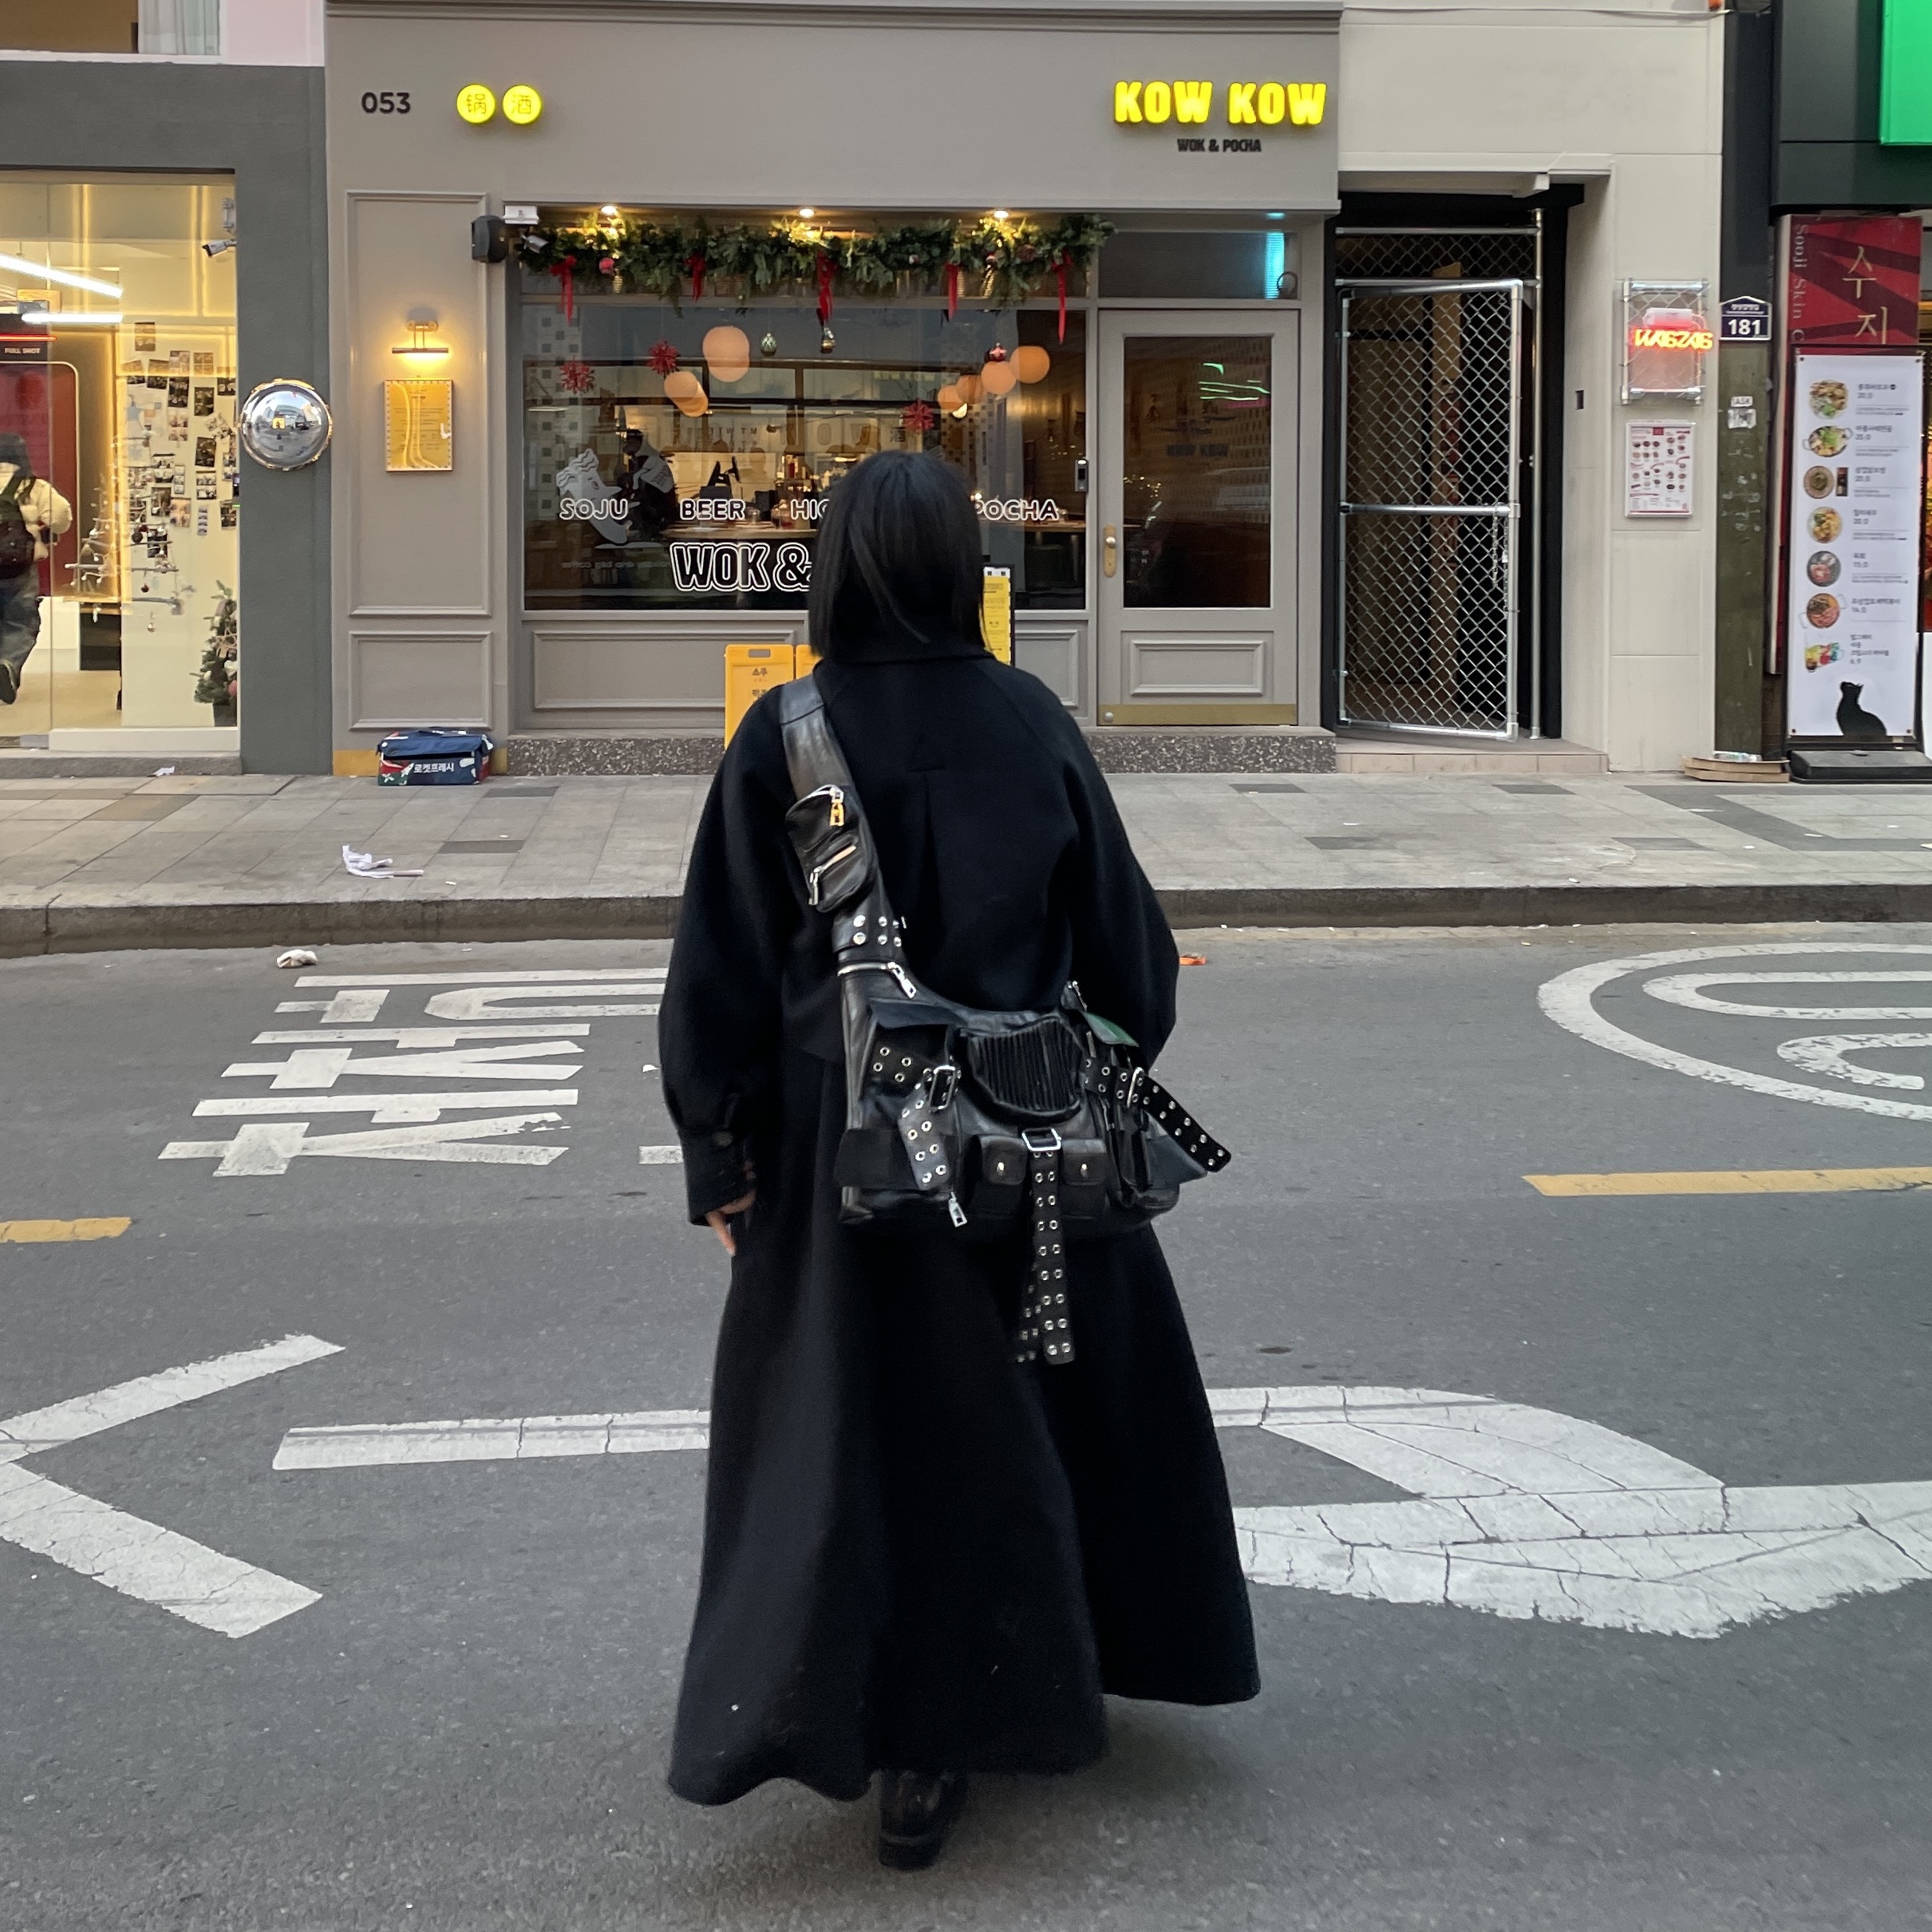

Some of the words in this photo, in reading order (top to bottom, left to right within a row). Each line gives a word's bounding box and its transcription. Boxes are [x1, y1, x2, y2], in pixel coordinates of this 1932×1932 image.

[362, 92, 411, 113] 053
[1114, 81, 1213, 124] KOW
[1228, 82, 1327, 125] KOW
[1177, 139, 1205, 152] WOK
[1208, 139, 1219, 152] &
[1223, 139, 1262, 152] POCHA
[1795, 223, 1808, 269] Sooji
[1792, 278, 1807, 320] Skin
[1728, 318, 1761, 335] 181
[559, 498, 628, 520] SOJU
[679, 498, 745, 520] BEER
[670, 543, 770, 592] WOK
[413, 762, 454, 773] 로켓프레시
